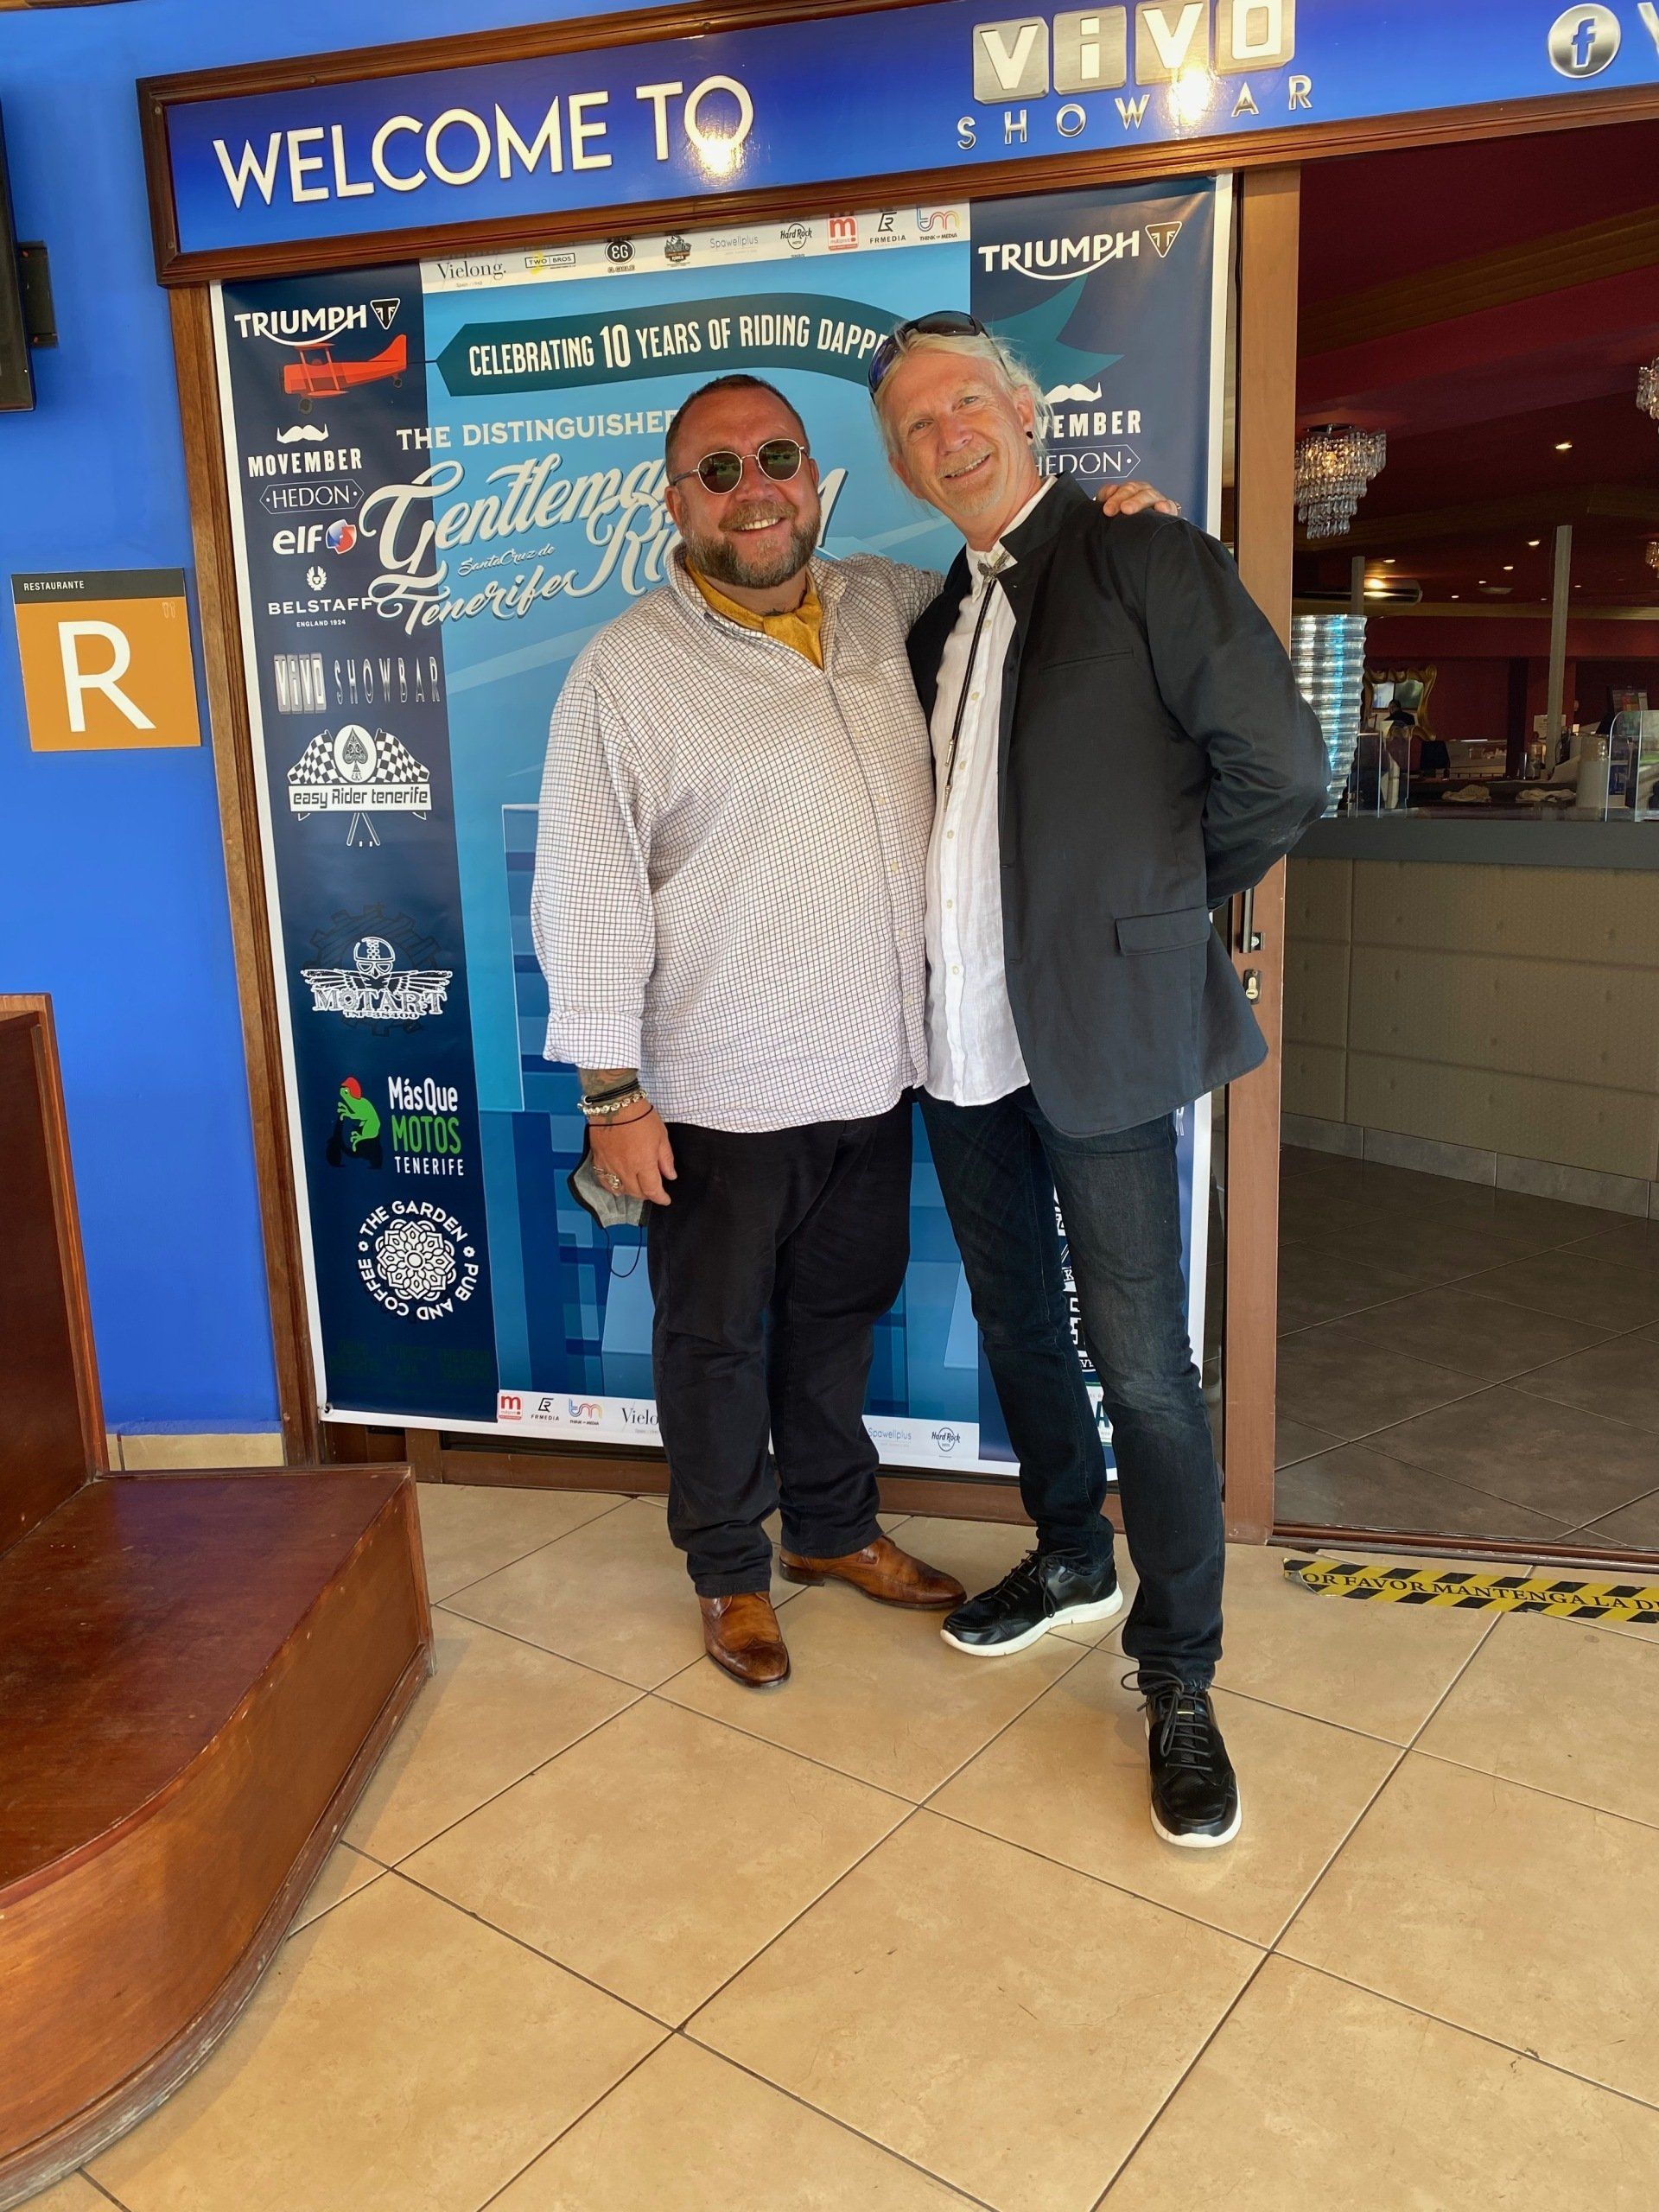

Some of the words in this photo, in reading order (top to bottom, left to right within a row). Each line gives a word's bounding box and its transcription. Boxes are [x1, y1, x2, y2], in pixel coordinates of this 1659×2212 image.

[957, 74, 1313, 150] SHOWAR
[213, 90, 613, 210] WELCOME
[636, 74, 755, 164] TO
[709, 234, 759, 249] Spawellplus
[780, 229, 796, 239] Hard
[797, 227, 812, 238] Rock
[869, 234, 906, 244] FRMEDIA
[977, 230, 1141, 281] TRIUMPH
[233, 304, 367, 346] TRIUMPH
[468, 335, 595, 377] CELEBRATING
[599, 323, 632, 369] 10
[635, 321, 702, 359] YEARS
[708, 317, 731, 351] OF
[739, 314, 811, 347] RIDING
[817, 318, 889, 360] DAPP
[396, 426, 451, 451] THE
[1036, 410, 1141, 440] VEMBER
[247, 448, 363, 478] MOVEMBER
[272, 486, 350, 509] HEDON
[272, 524, 324, 555] elf
[23, 580, 85, 591] RESTAURANTE
[368, 560, 577, 636] Tenerife
[268, 597, 373, 615] BELSTAFF
[58, 620, 156, 732] R
[334, 656, 441, 705] SHOWBAR
[293, 791, 329, 809] easy
[332, 787, 368, 805] Rider
[371, 785, 429, 804] tenerife
[312, 988, 448, 1015] MOTART
[391, 1114, 461, 1154] MOTOS
[394, 1155, 465, 1176] TENERIFE
[359, 1205, 390, 1236] THE
[391, 1199, 468, 1243] GARDEN
[358, 1258, 410, 1316] COFFEE
[454, 1262, 479, 1301] PUB
[416, 1298, 454, 1320] AND
[621, 1407, 658, 1426] Vielo
[868, 1427, 912, 1442] Spawellplus
[931, 1431, 946, 1440] Hard
[946, 1433, 961, 1443] Rock
[1344, 1575, 1427, 1592] FAVOR
[1432, 1583, 1588, 1605] MANTENGA
[1592, 1595, 1630, 1609] LA
